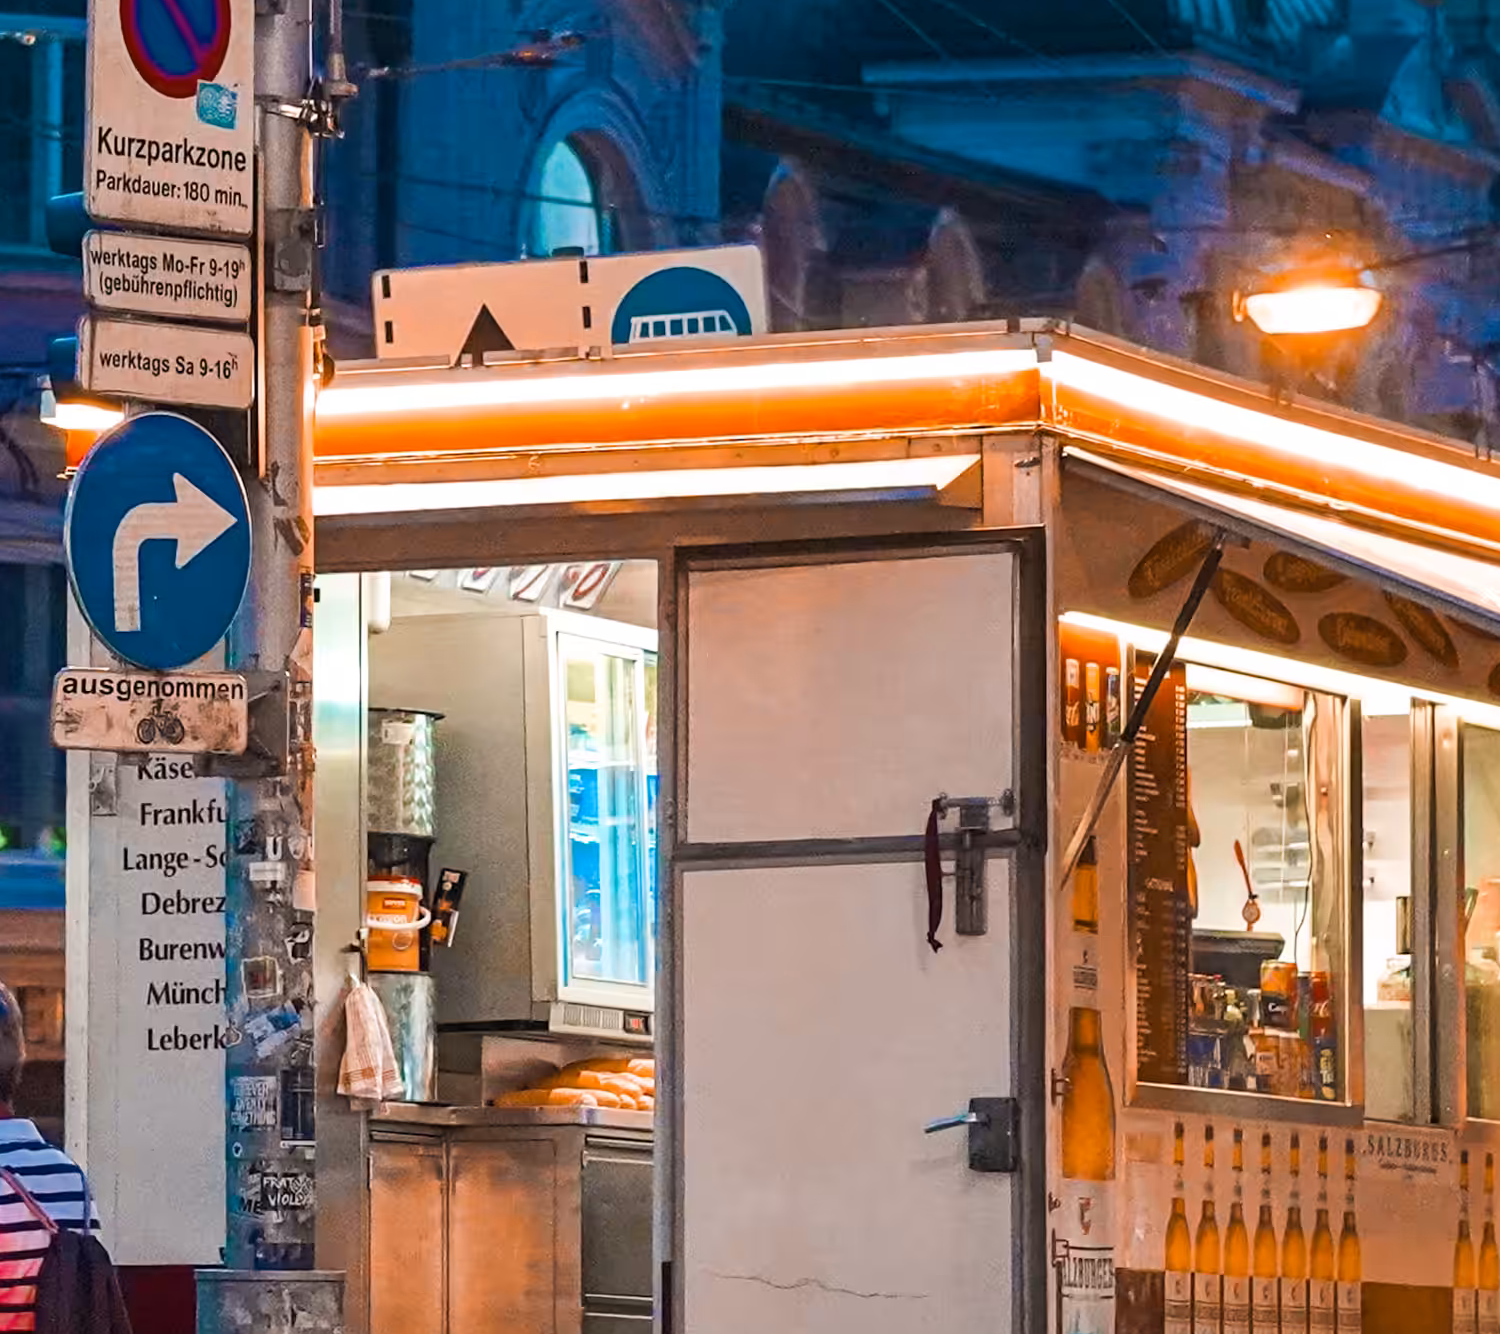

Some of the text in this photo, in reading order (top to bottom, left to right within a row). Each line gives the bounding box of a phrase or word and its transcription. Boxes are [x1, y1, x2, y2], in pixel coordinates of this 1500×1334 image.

[98, 126, 246, 172] Kurzparkzone
[96, 169, 181, 199] Parkdauer:
[183, 180, 210, 203] 180
[90, 248, 158, 275] werktags
[162, 252, 206, 276] Mo-Fr
[99, 271, 239, 308] (gebührenpflichtig)
[100, 350, 171, 377] werktags
[175, 355, 195, 376] Sa
[62, 676, 245, 702] ausgenommen
